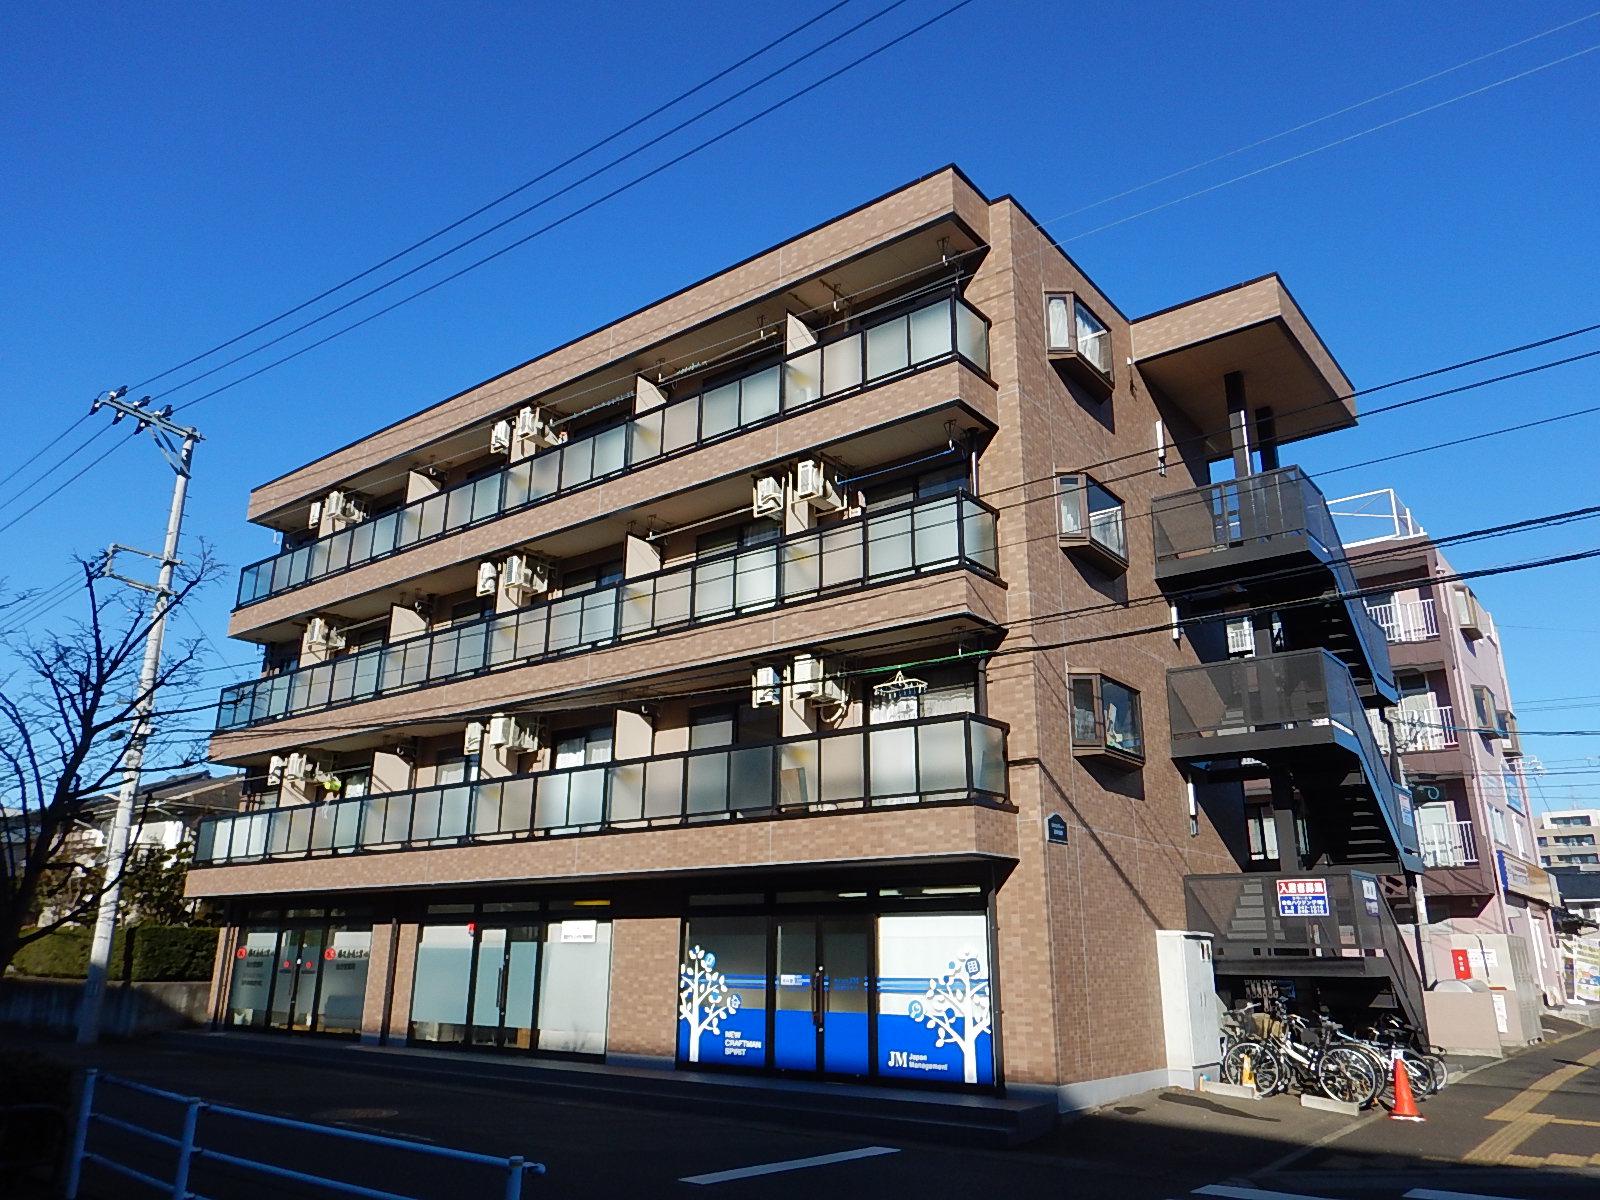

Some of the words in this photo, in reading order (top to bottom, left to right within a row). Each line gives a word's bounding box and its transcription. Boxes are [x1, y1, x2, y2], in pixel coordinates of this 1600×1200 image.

[725, 1031, 742, 1039] NEW
[724, 1047, 747, 1056] SPIRIT
[888, 1051, 908, 1067] JM
[909, 1053, 928, 1061] Japan
[909, 1061, 948, 1071] Management
